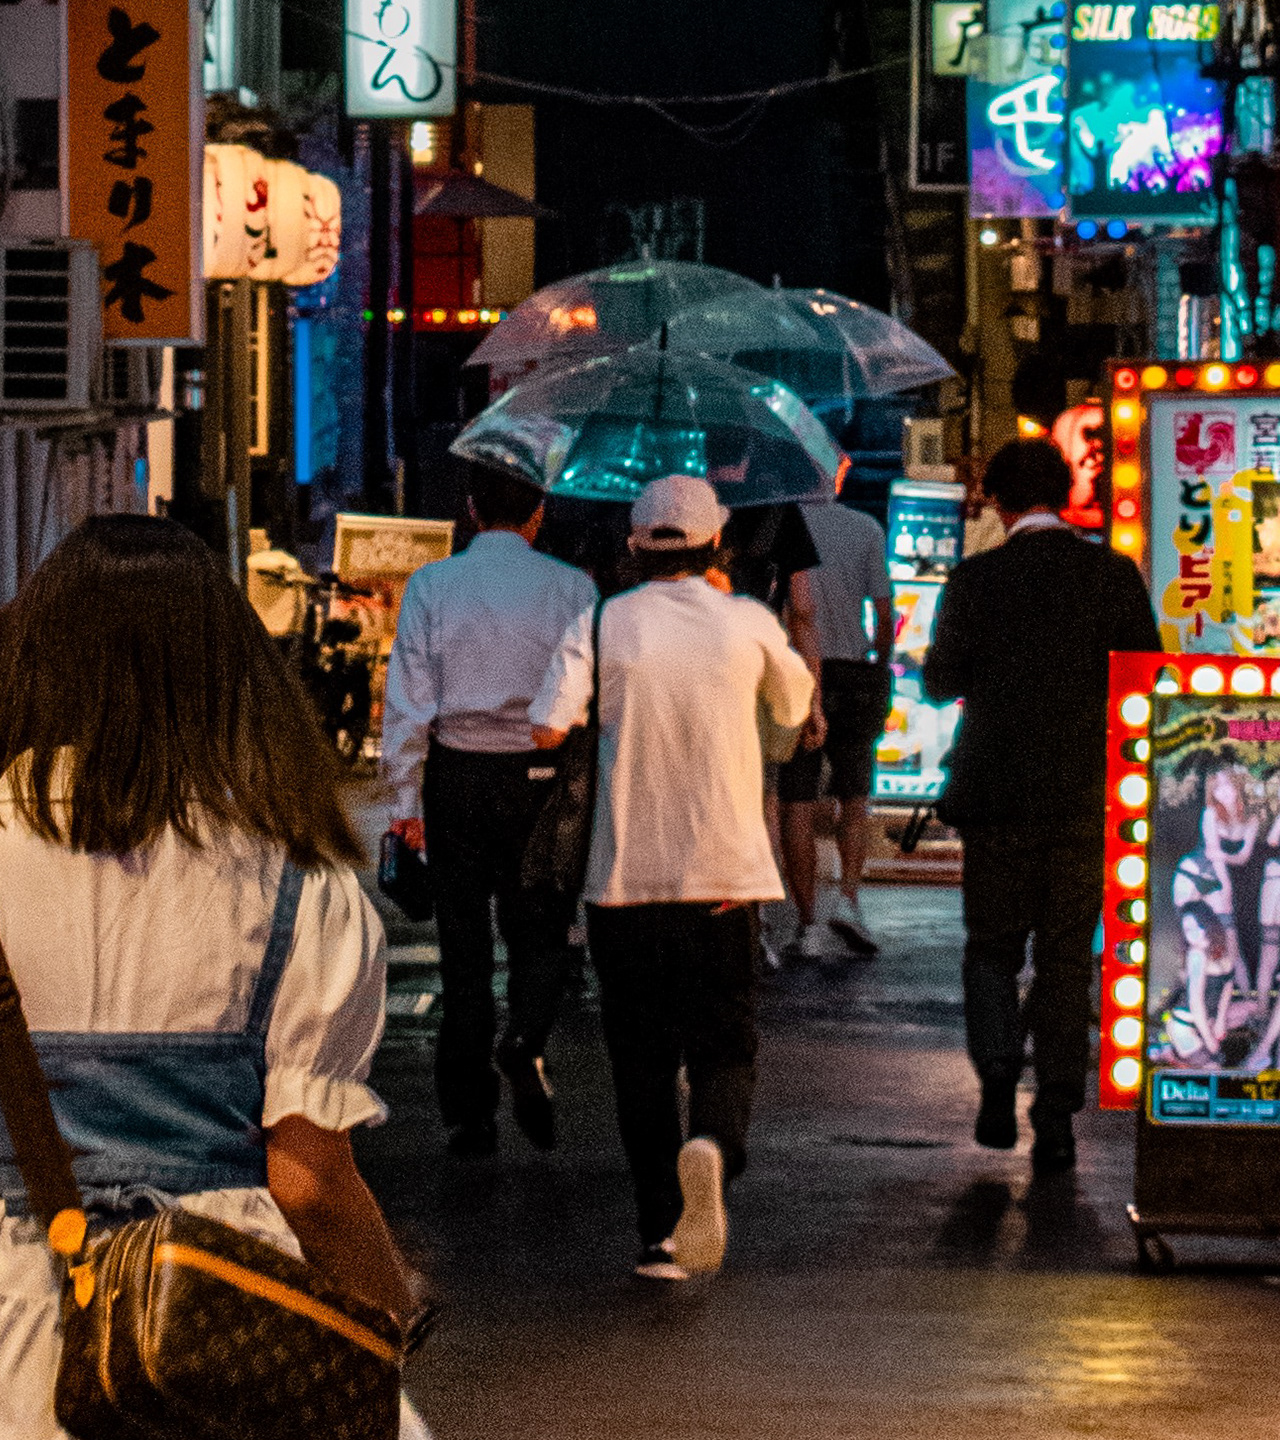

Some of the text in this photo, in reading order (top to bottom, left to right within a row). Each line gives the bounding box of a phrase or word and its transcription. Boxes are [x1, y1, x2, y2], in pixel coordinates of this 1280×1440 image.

[1071, 3, 1137, 42] SILK
[96, 6, 177, 325] とまり木
